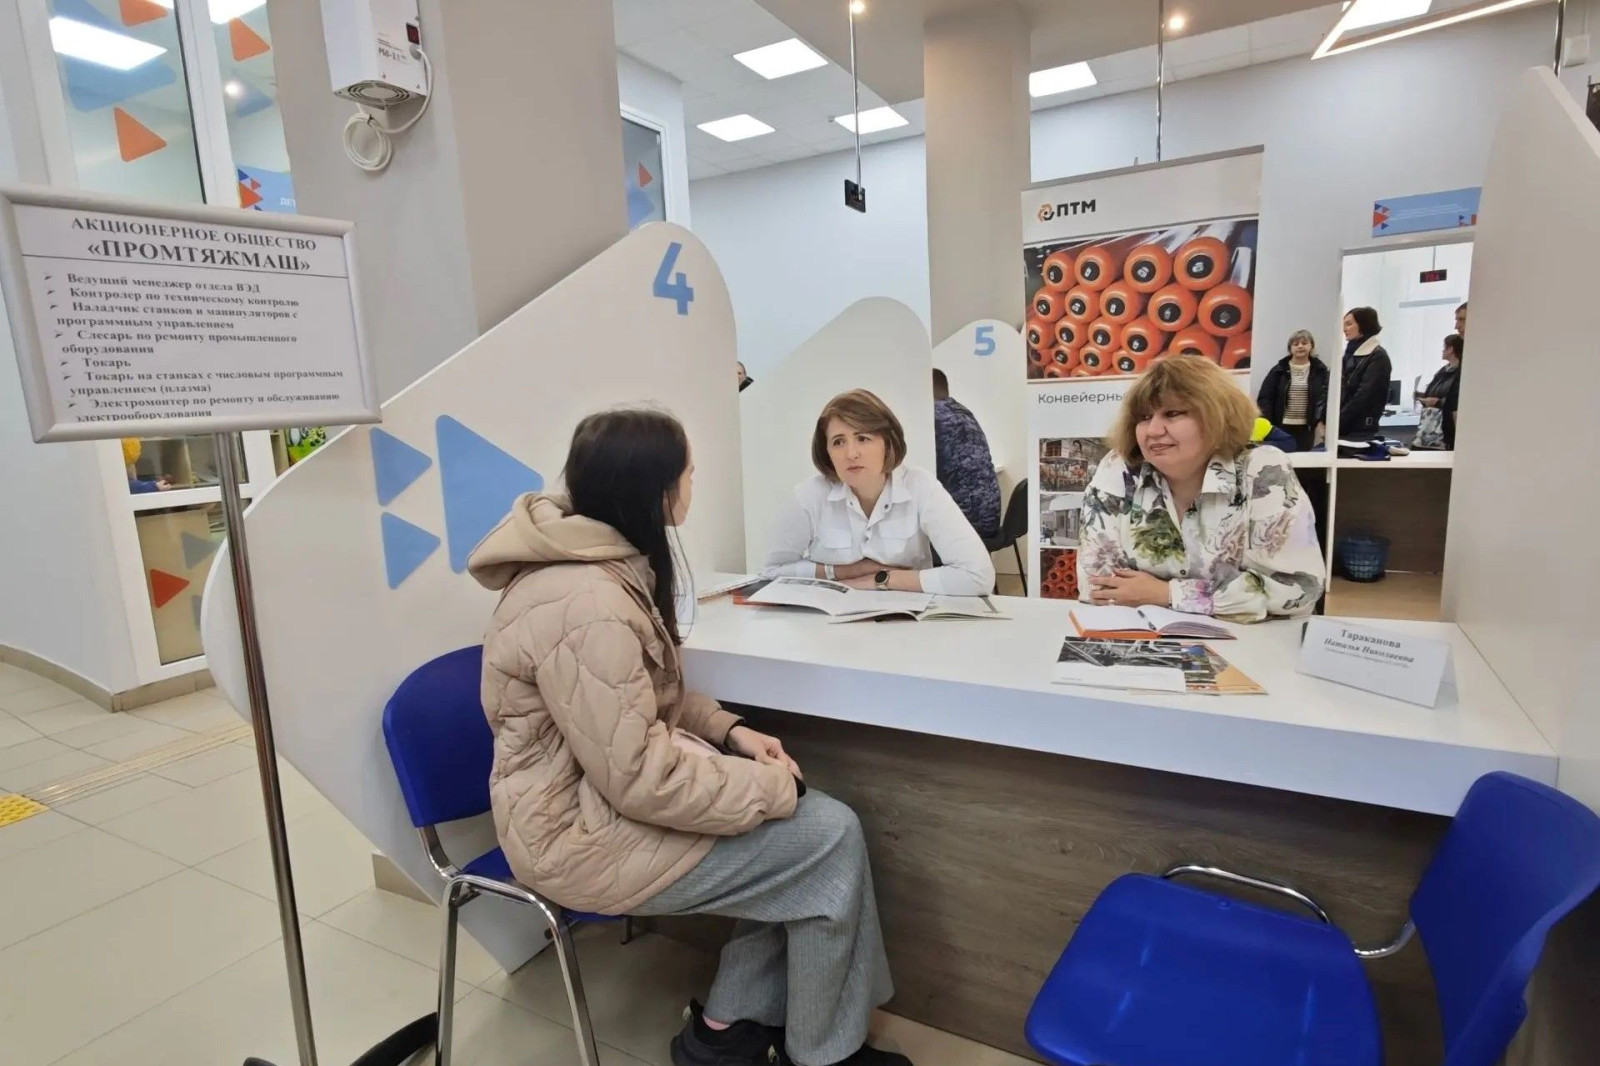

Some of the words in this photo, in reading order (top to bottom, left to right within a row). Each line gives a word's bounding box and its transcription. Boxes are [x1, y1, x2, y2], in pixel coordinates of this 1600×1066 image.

[1056, 199, 1096, 218] ПТМ
[71, 218, 220, 242] АКЦИОНЕРНОЕ
[224, 231, 316, 251] ОБЩЕСТВО
[88, 240, 310, 271] «ПРОМТЯЖМАШ»
[132, 279, 192, 291] менеджер
[195, 282, 233, 291] отдела
[236, 283, 260, 293] ВЭД
[653, 241, 695, 316] 4
[70, 287, 141, 301] Контролер
[146, 292, 160, 301] по
[165, 293, 244, 306] техническому
[248, 297, 299, 308] контролю
[72, 302, 140, 313] Наладчик
[143, 305, 193, 315] станков
[196, 308, 203, 316] и
[206, 308, 290, 320] манипуляторов
[57, 317, 153, 328] программным
[157, 319, 234, 330] управлением
[77, 330, 133, 342] Слесарь
[155, 333, 204, 343] ремонту
[208, 333, 297, 344] промышленного
[974, 325, 996, 357] 5
[62, 344, 154, 355] оборудования
[82, 357, 131, 369] Токарь
[85, 371, 134, 382] Токарь
[156, 372, 204, 380] станках
[215, 371, 271, 379] числовым
[274, 370, 343, 380] программным
[70, 385, 156, 397] управлением
[160, 383, 211, 394] (плазма)
[90, 397, 189, 409] Электромонтер
[193, 397, 206, 405] по
[210, 396, 254, 406] ремонту
[267, 393, 340, 404] обслуживанию
[1341, 629, 1401, 649] Тараканова
